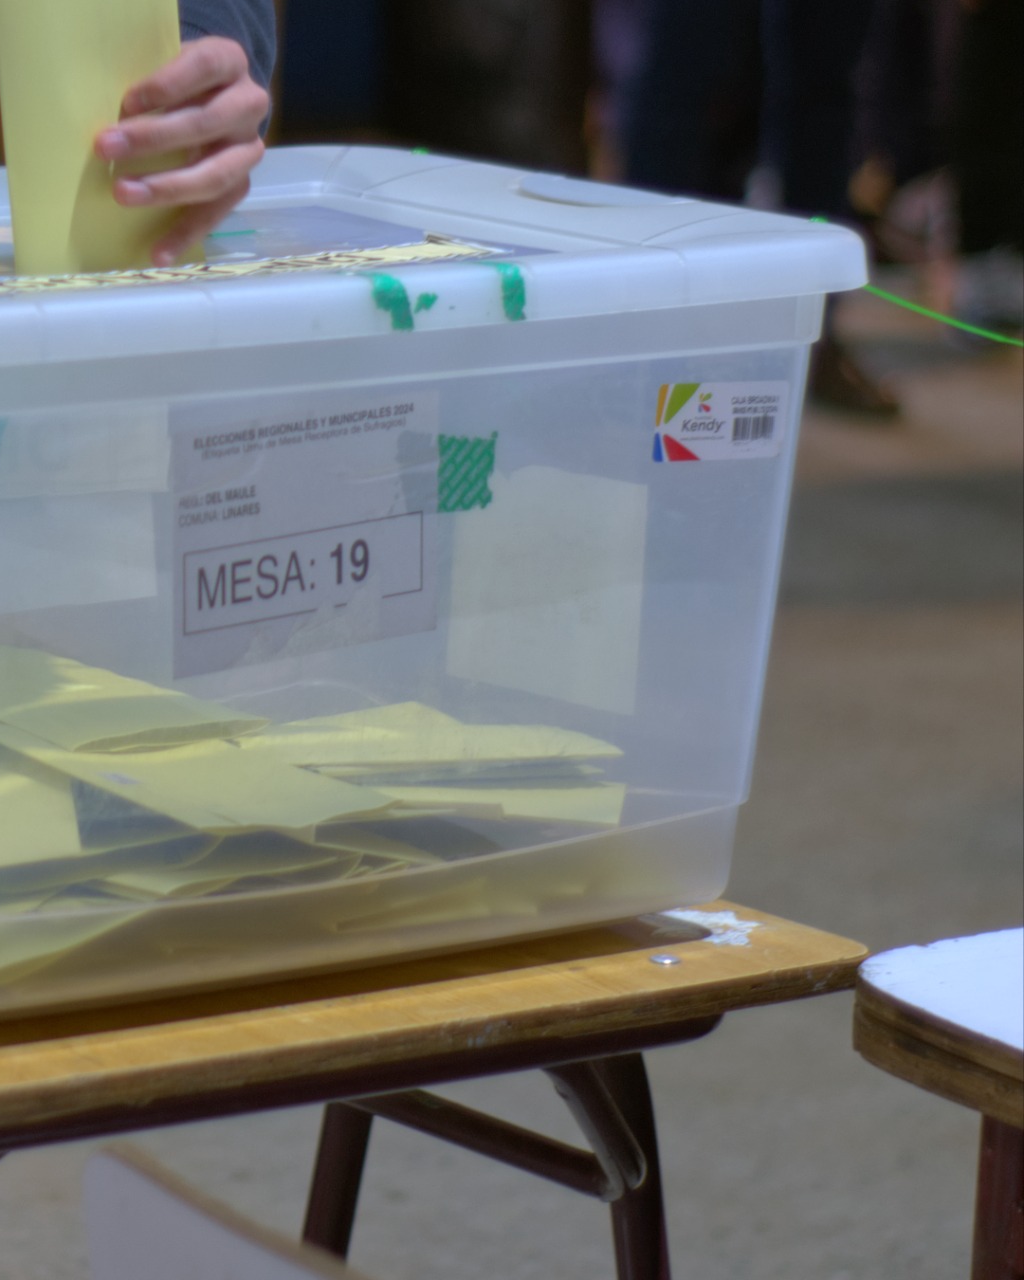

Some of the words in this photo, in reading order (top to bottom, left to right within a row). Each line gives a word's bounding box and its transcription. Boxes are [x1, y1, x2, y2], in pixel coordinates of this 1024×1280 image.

[194, 428, 256, 450] ELECCIONES
[257, 417, 318, 439] REGIONALES
[320, 416, 327, 428] Y
[328, 406, 392, 427] MUNICIPALES
[393, 402, 414, 416] 2024
[350, 424, 362, 435] de
[681, 419, 725, 434] Kendy
[205, 491, 223, 506] DEL
[224, 484, 257, 502] MAULE
[222, 501, 261, 520] LINARES
[196, 550, 316, 611] MESA:
[329, 538, 370, 586] 19
